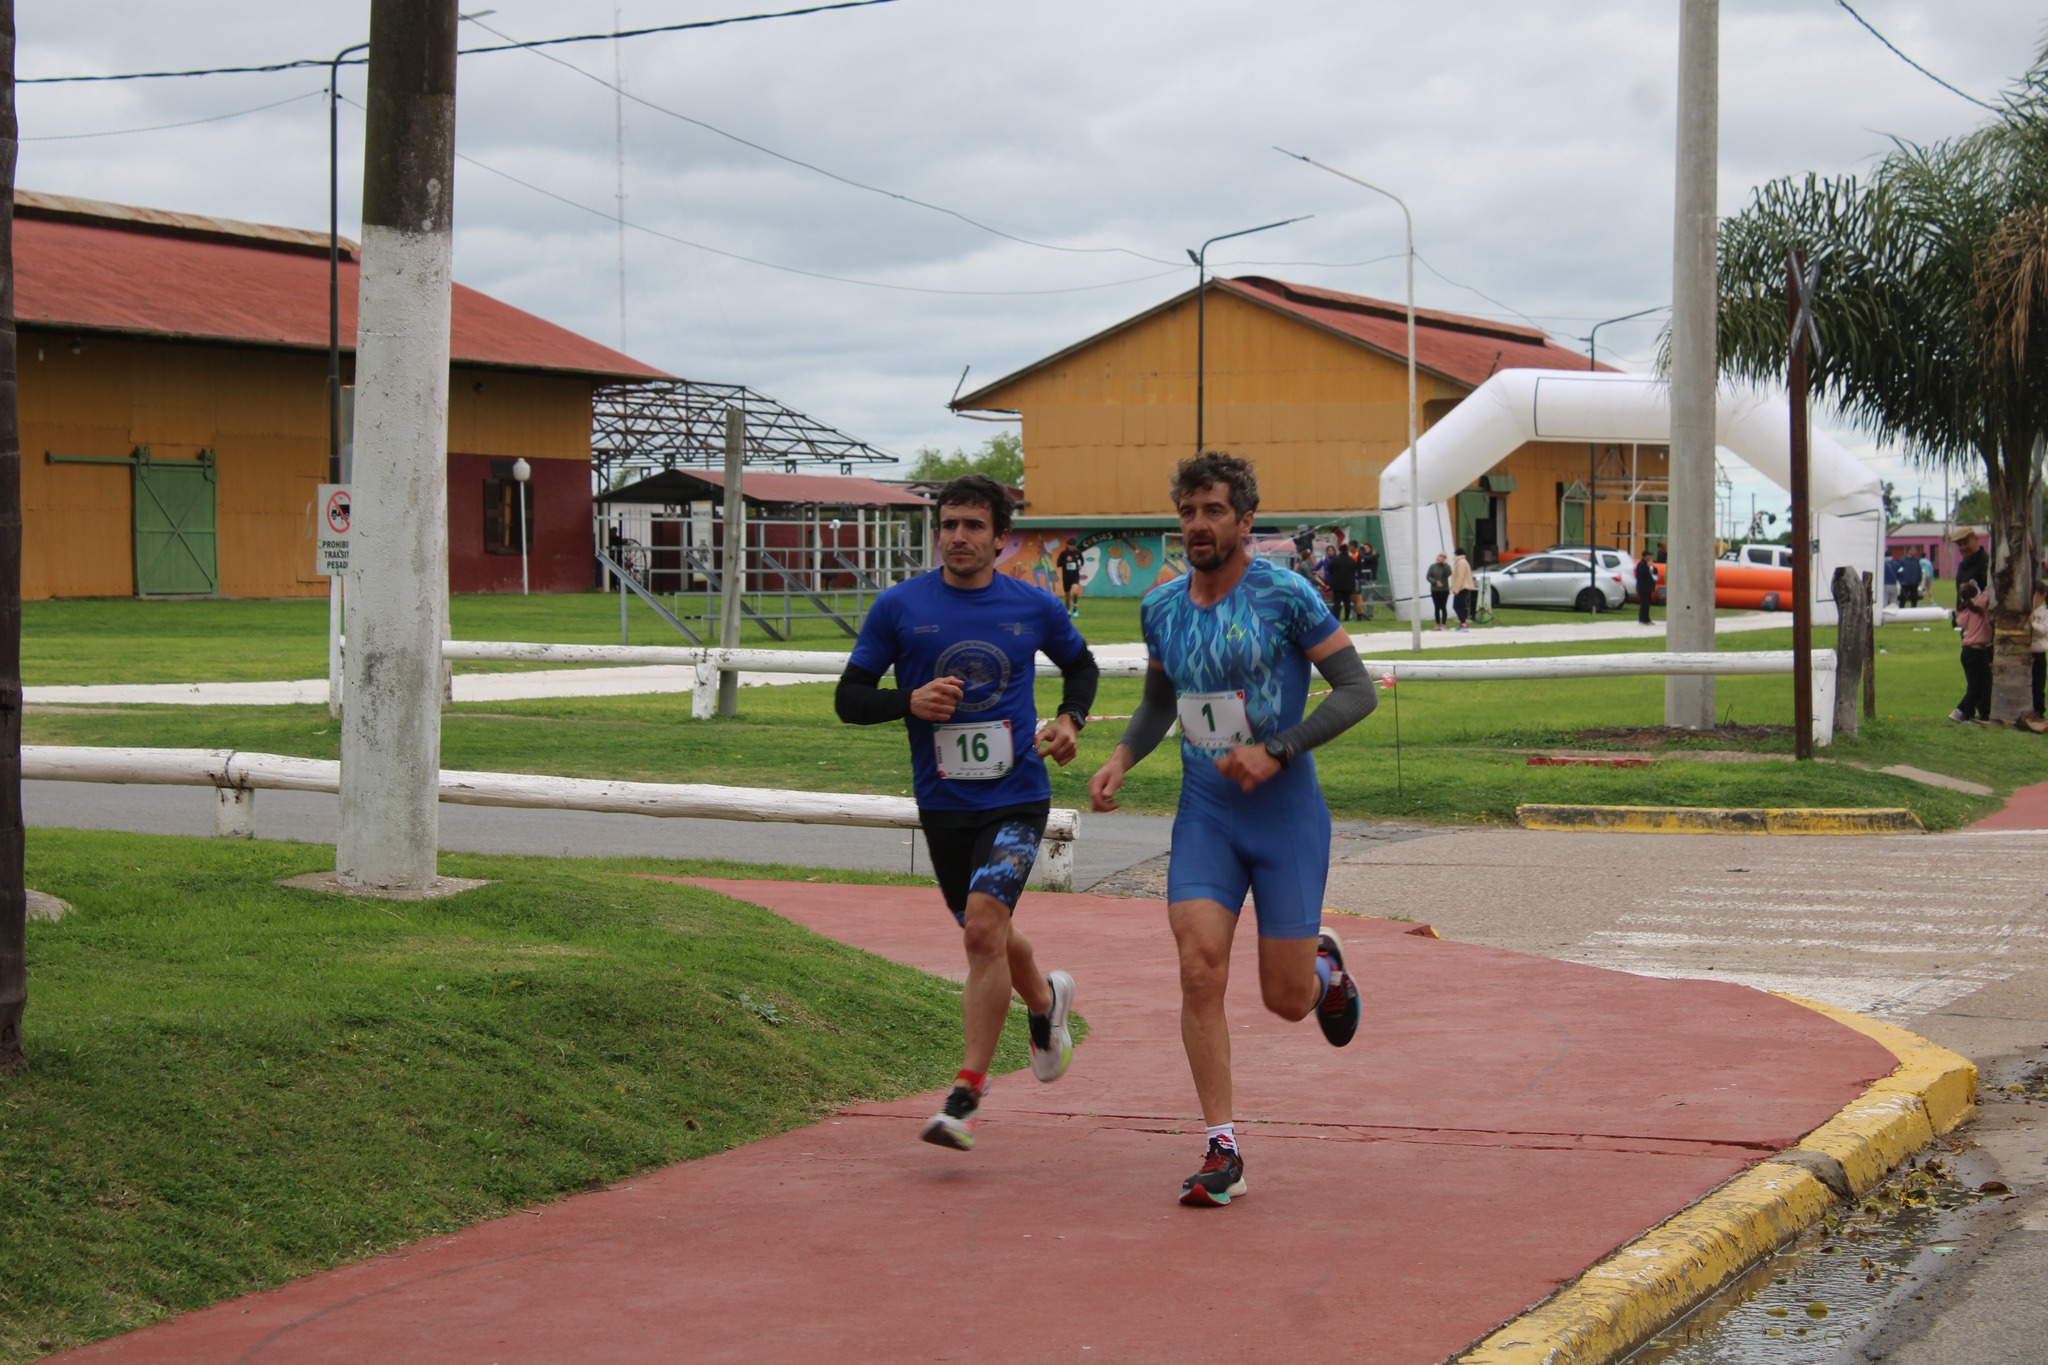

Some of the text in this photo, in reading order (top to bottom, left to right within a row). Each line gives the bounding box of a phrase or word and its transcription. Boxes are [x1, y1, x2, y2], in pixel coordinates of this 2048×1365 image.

[322, 540, 349, 549] PROHIBI
[327, 560, 349, 569] PESAD
[1201, 703, 1216, 732] 1
[956, 732, 990, 763] 16
